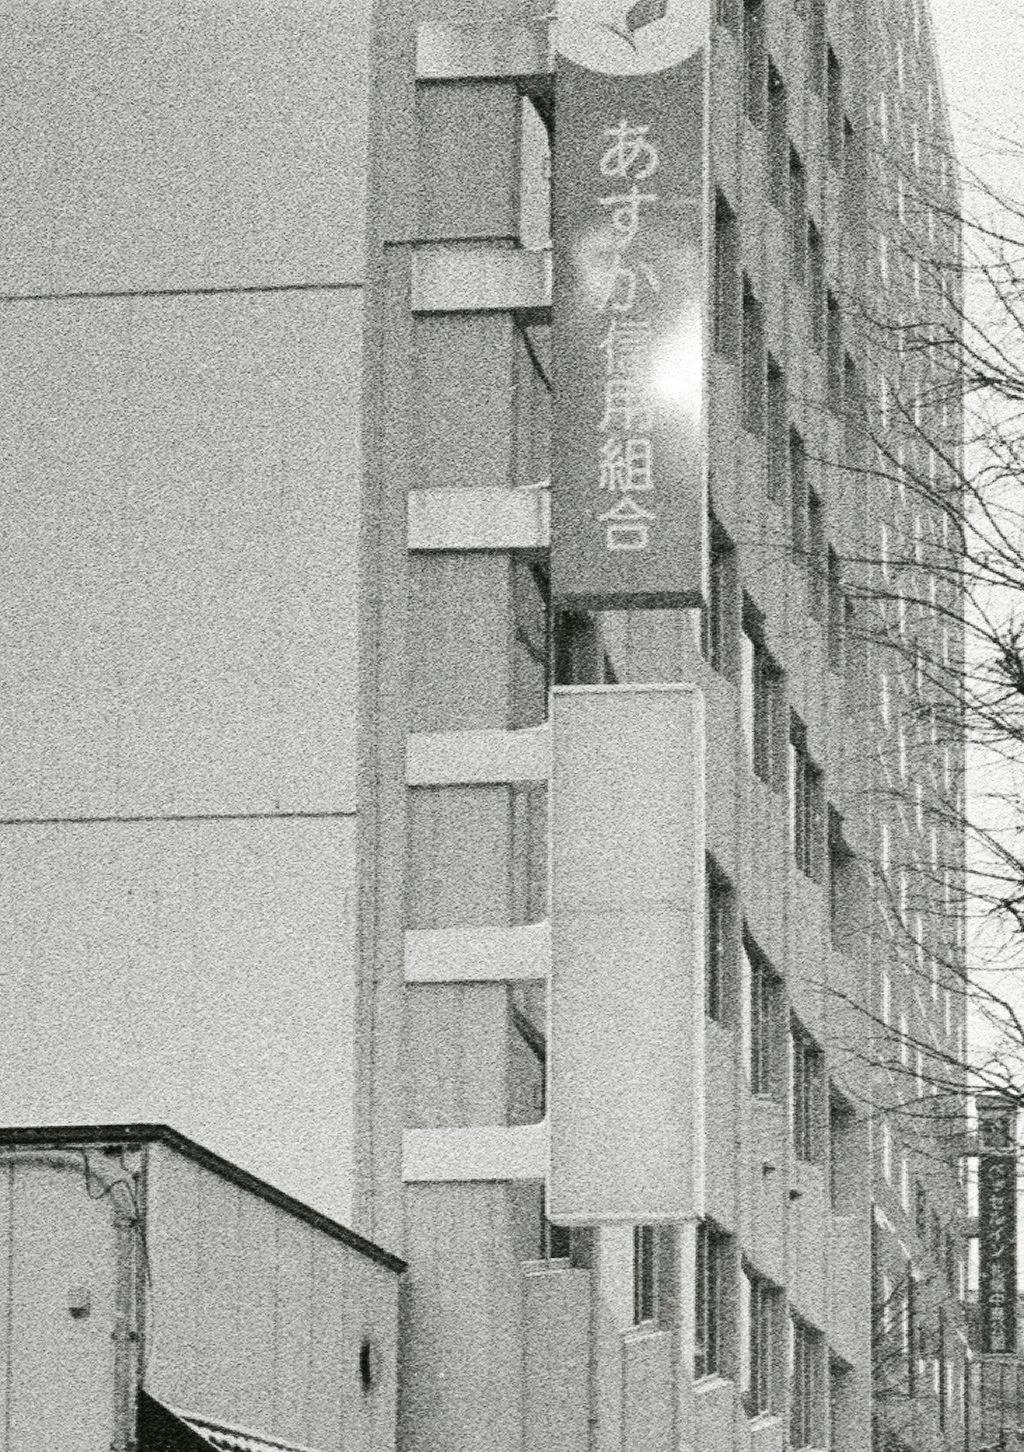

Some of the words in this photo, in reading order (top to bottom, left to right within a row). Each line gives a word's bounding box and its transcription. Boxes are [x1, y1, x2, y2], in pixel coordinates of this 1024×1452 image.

[599, 119, 660, 551] あすか信用組合
